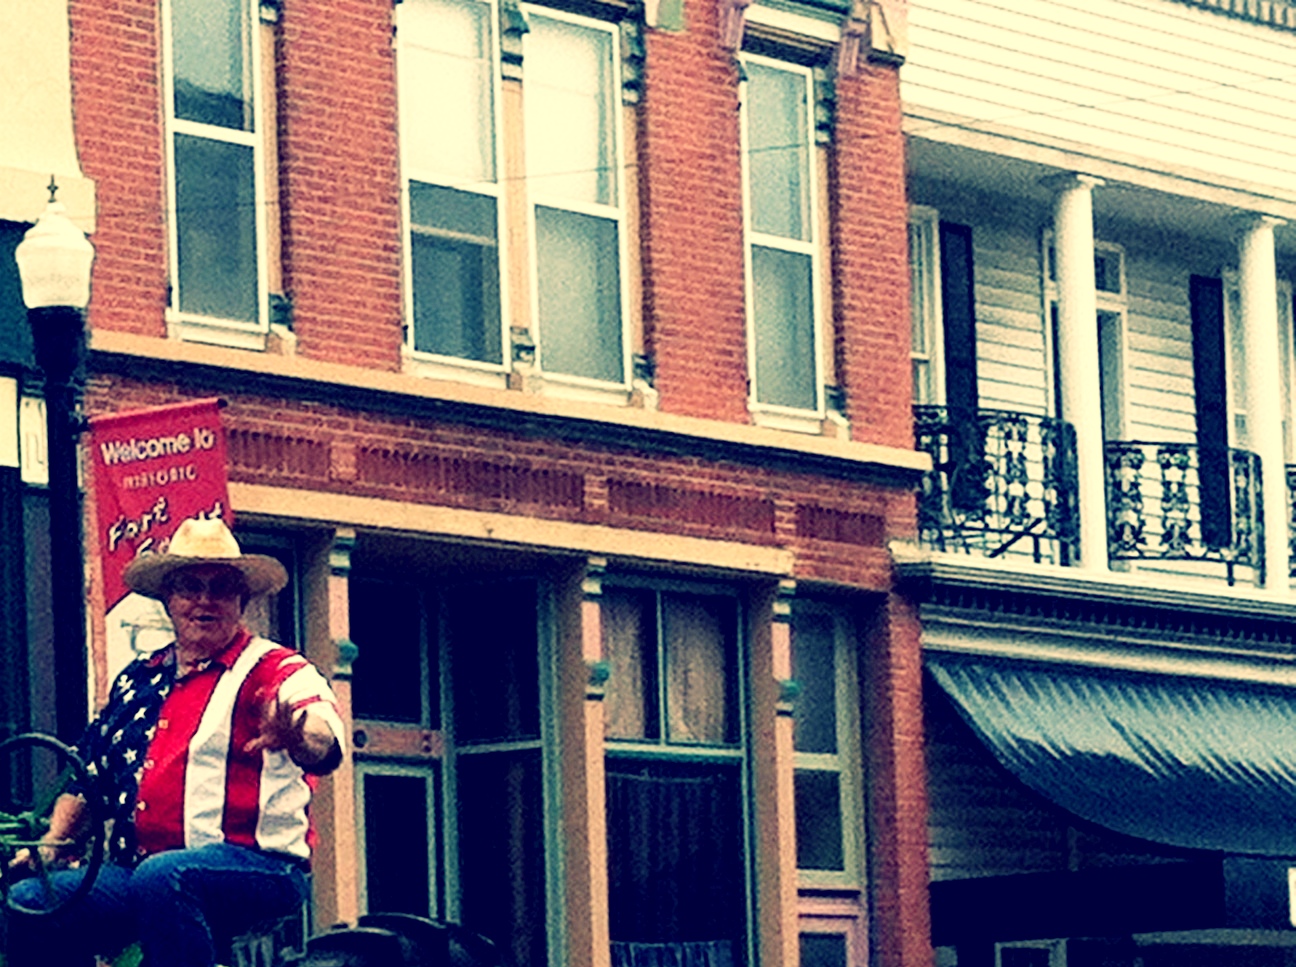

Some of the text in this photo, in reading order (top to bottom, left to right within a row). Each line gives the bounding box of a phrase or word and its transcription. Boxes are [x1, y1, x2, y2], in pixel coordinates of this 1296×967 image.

[101, 427, 215, 466] Welcome to
[108, 496, 169, 552] Fort
